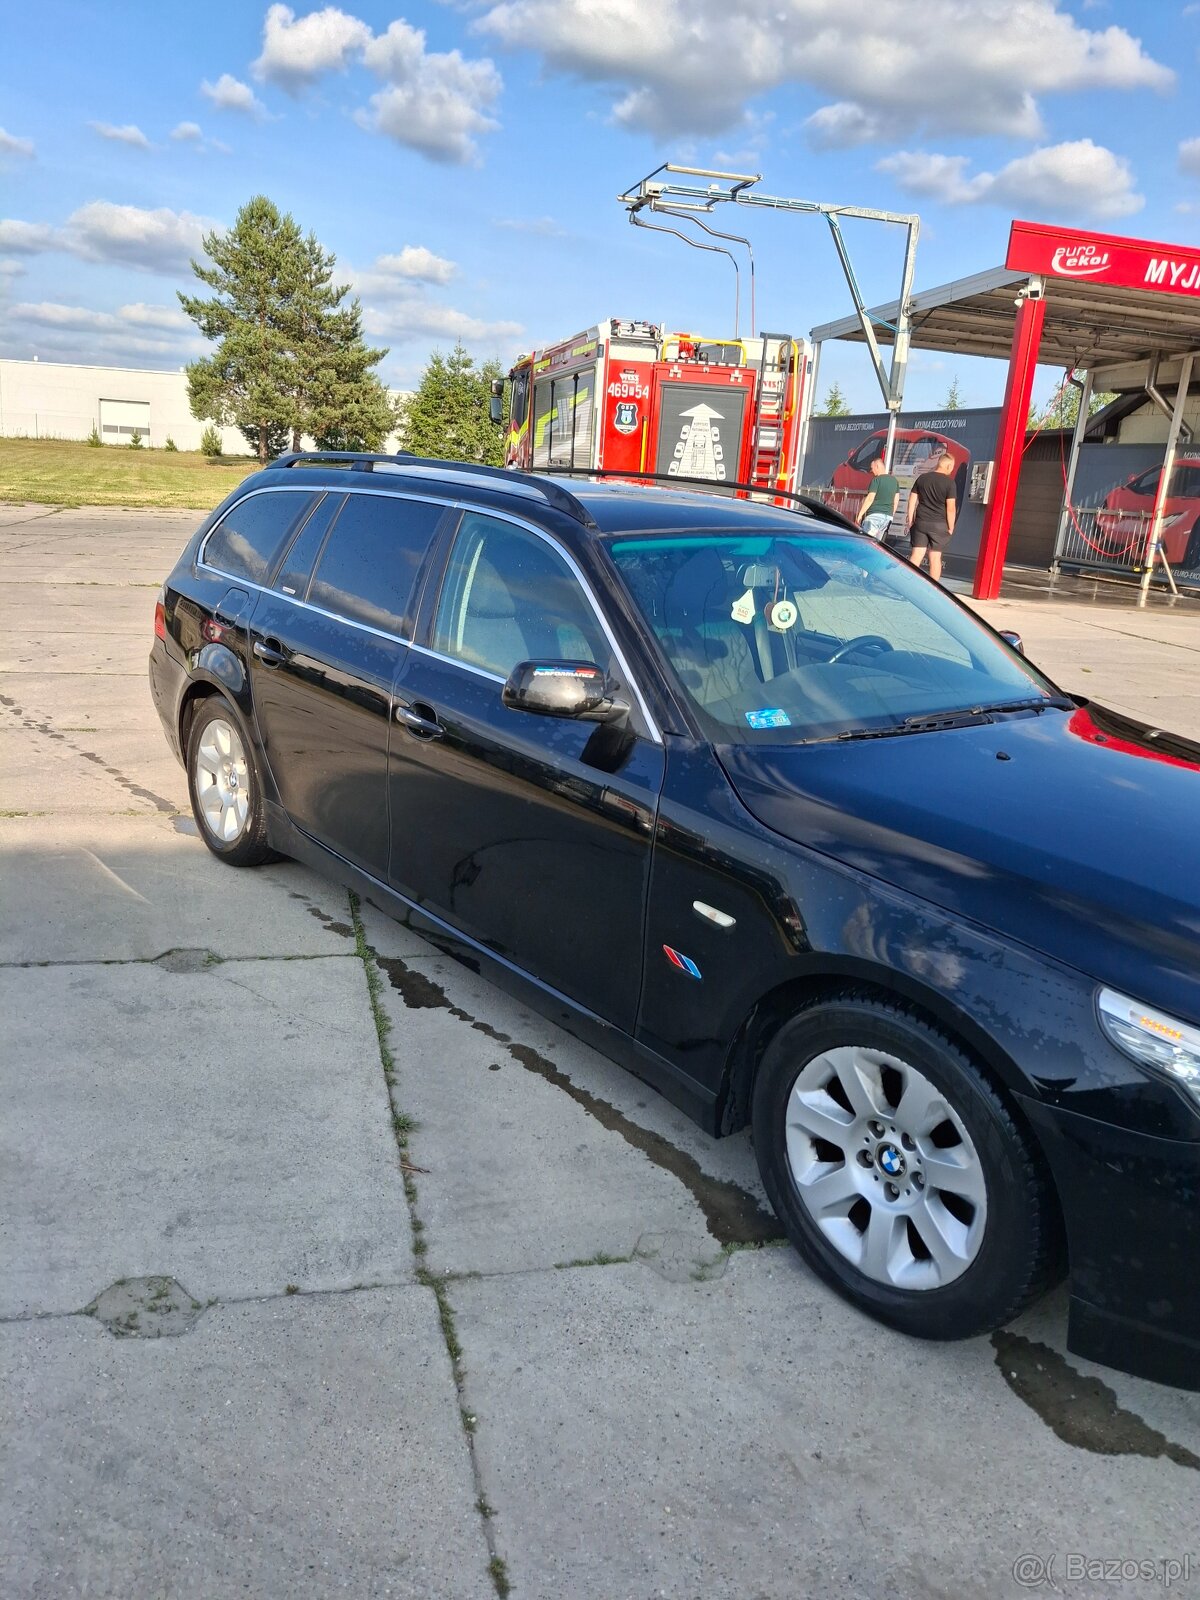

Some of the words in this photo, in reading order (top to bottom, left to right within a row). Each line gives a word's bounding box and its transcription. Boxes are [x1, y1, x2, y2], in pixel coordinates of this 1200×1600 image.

[1054, 246, 1096, 257] euro
[1066, 253, 1109, 267] ekol
[607, 382, 629, 398] 469
[635, 384, 650, 399] 54
